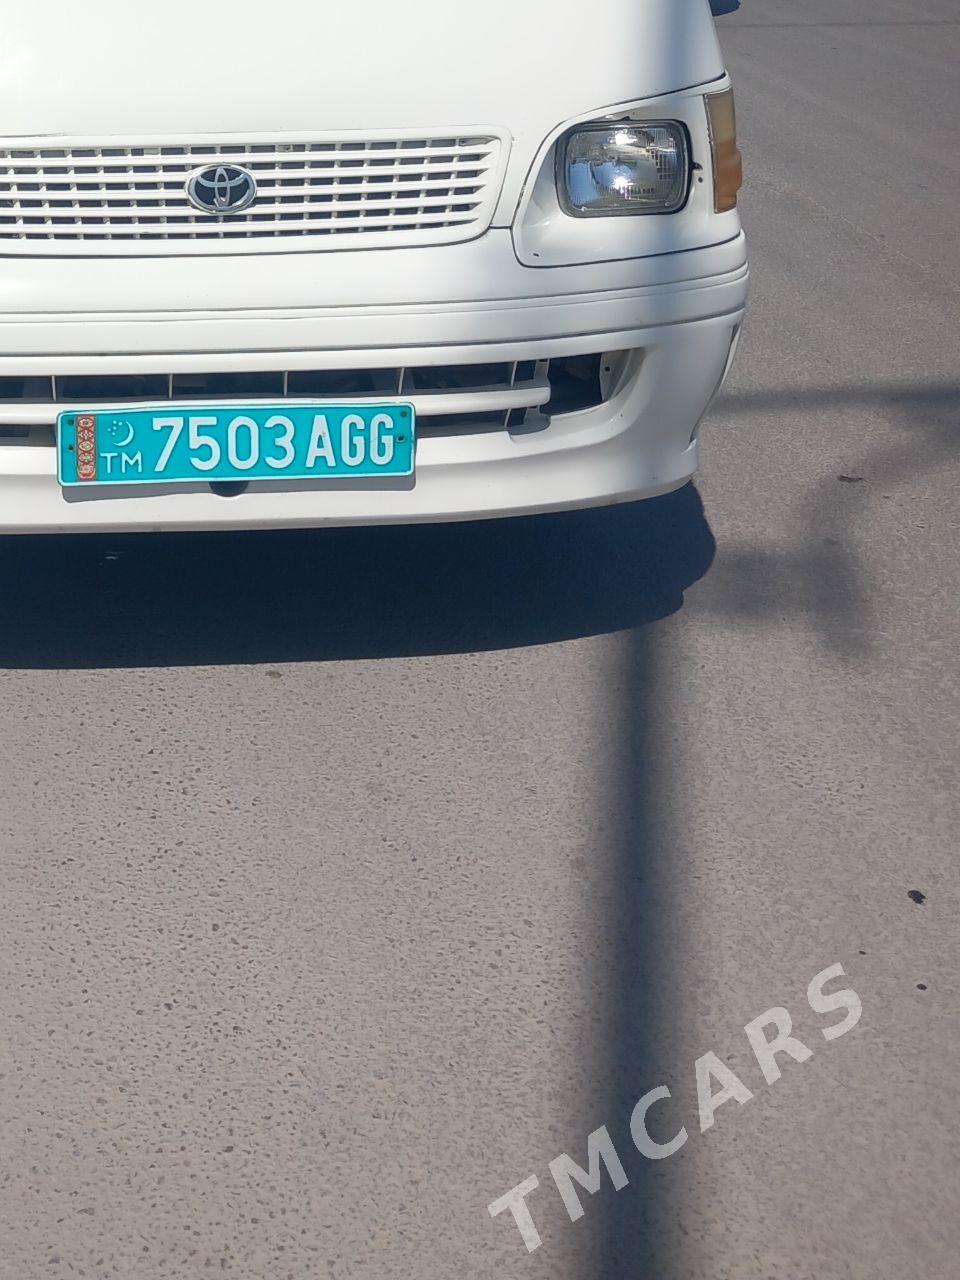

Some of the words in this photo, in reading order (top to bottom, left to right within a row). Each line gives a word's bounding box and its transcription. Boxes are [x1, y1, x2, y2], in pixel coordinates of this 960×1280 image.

[100, 450, 142, 474] TM
[152, 415, 295, 473] 7503
[305, 413, 394, 469] AGG
